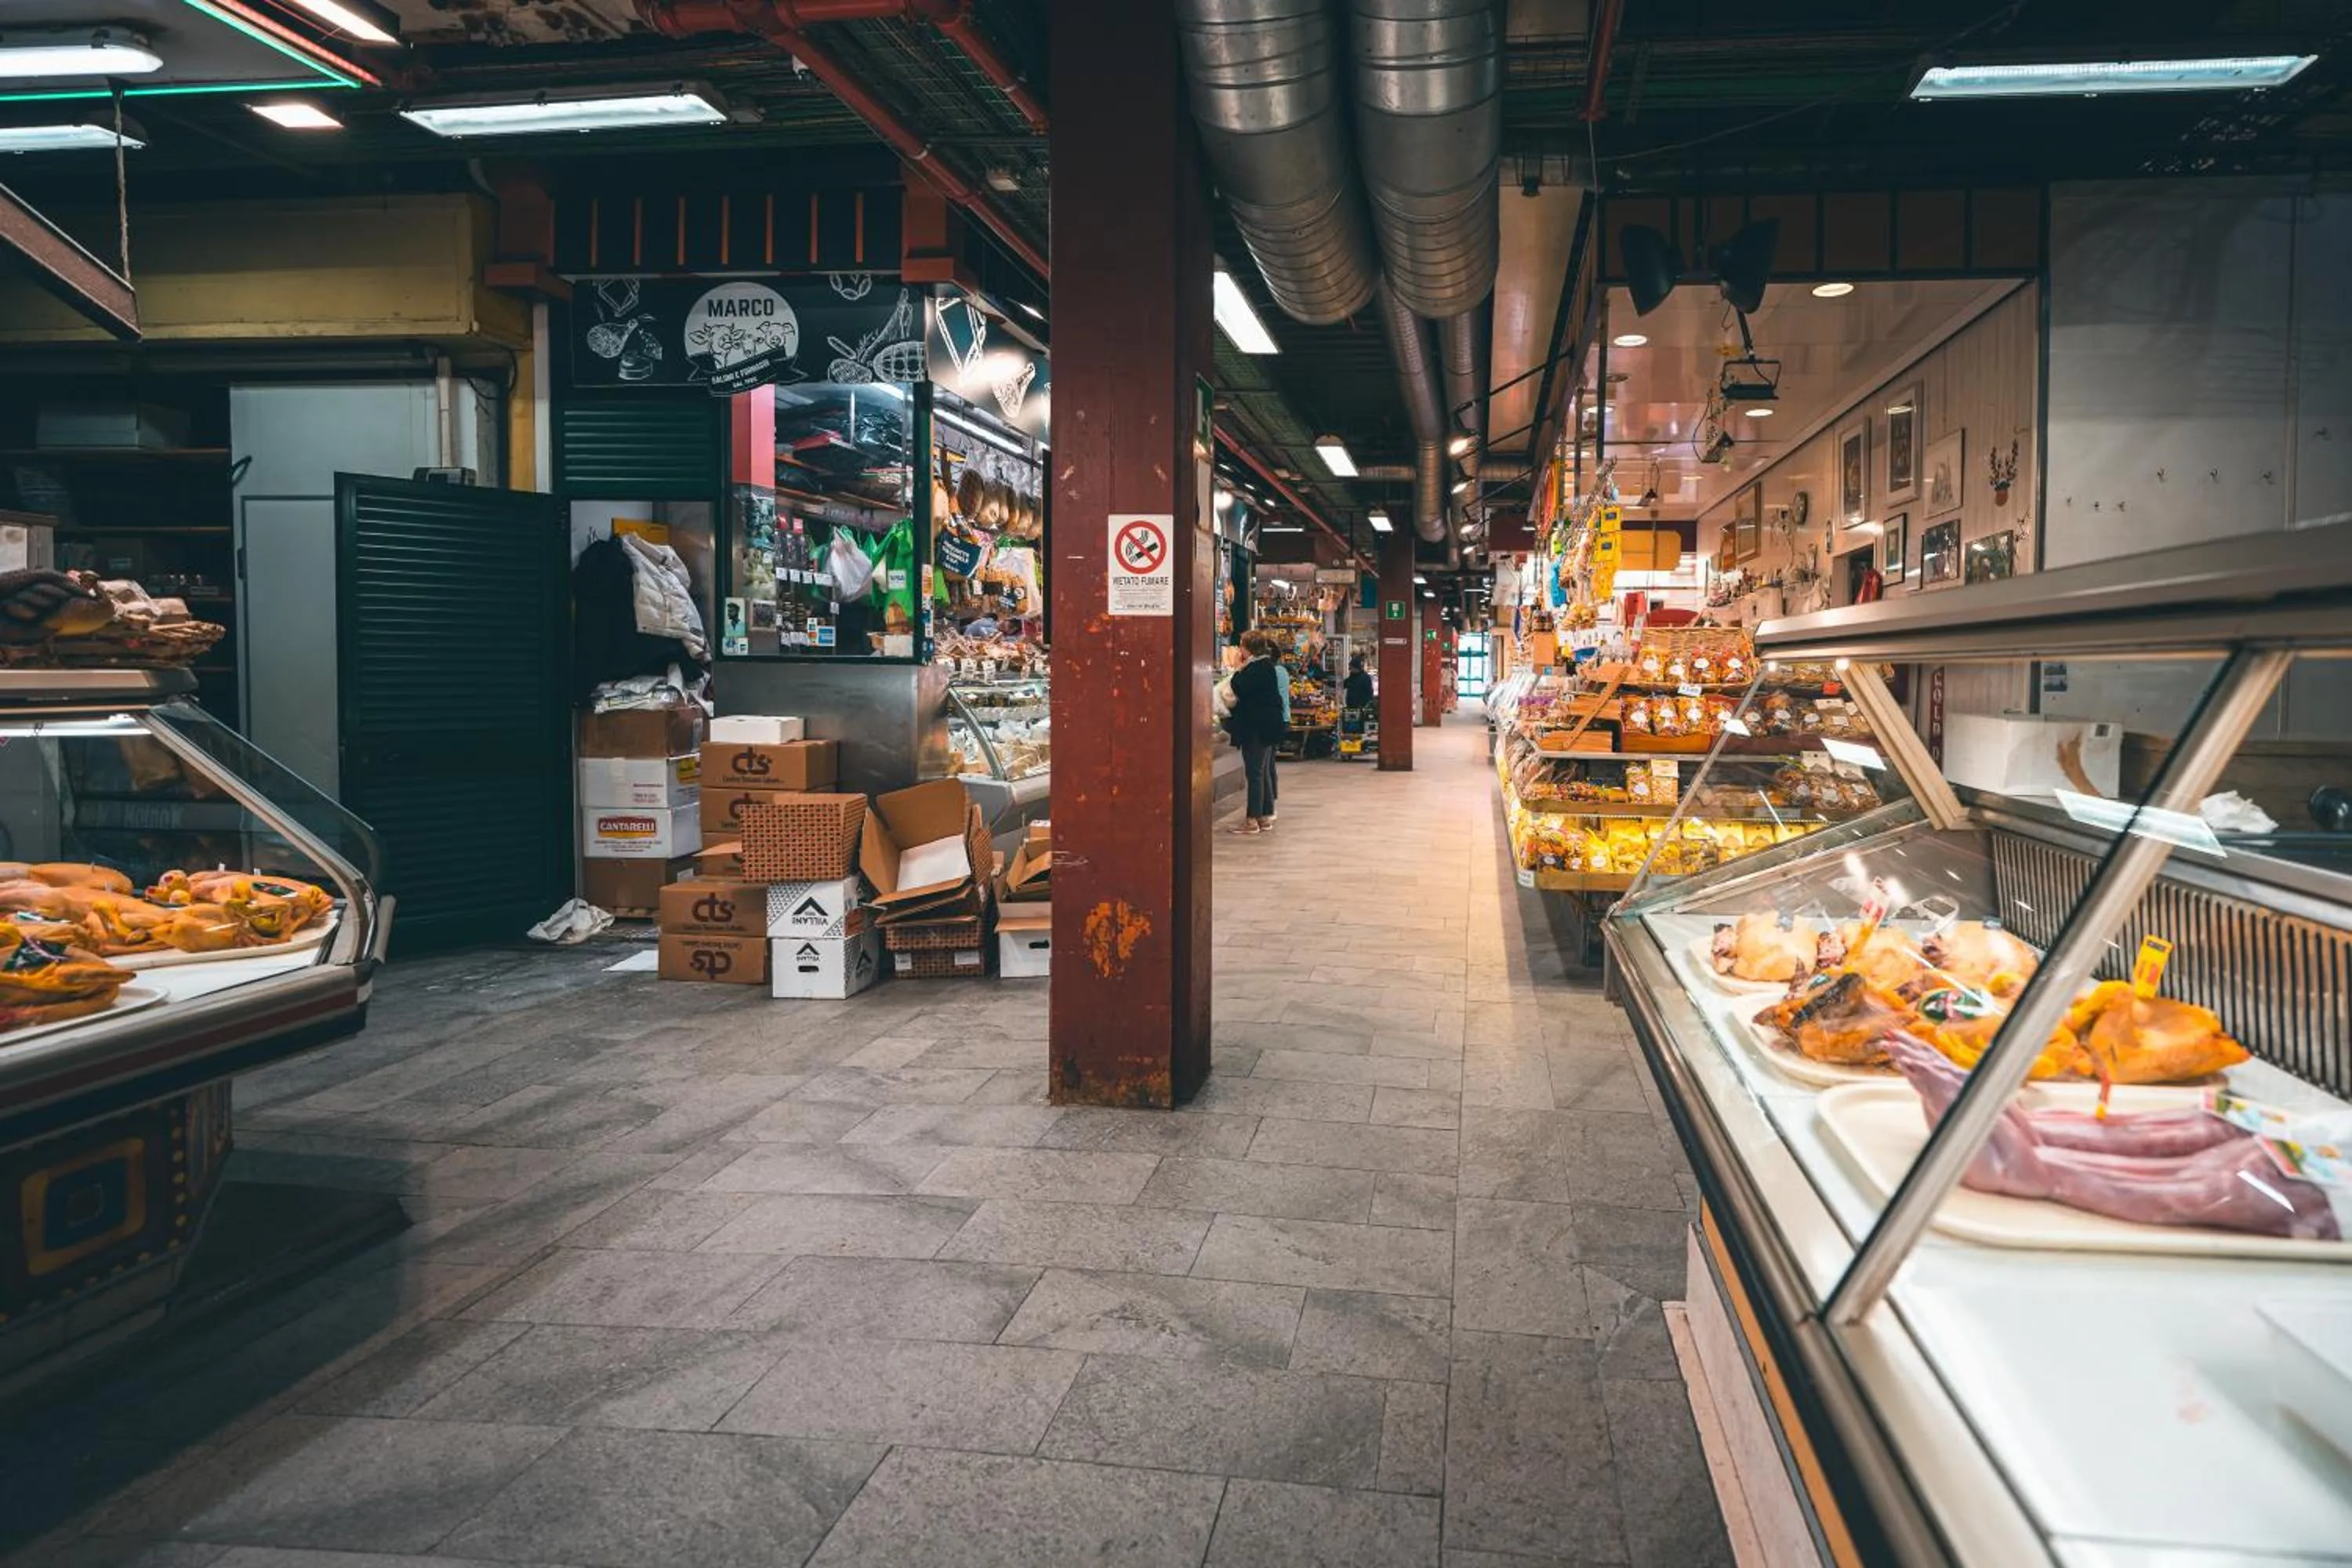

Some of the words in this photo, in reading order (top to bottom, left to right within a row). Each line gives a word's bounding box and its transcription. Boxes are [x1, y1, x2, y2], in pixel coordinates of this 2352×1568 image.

[708, 299, 774, 317] MARCO
[1141, 576, 1170, 586] FUMARE
[600, 822, 655, 832] CANTARELLI
[792, 916, 829, 926] VILLANI
